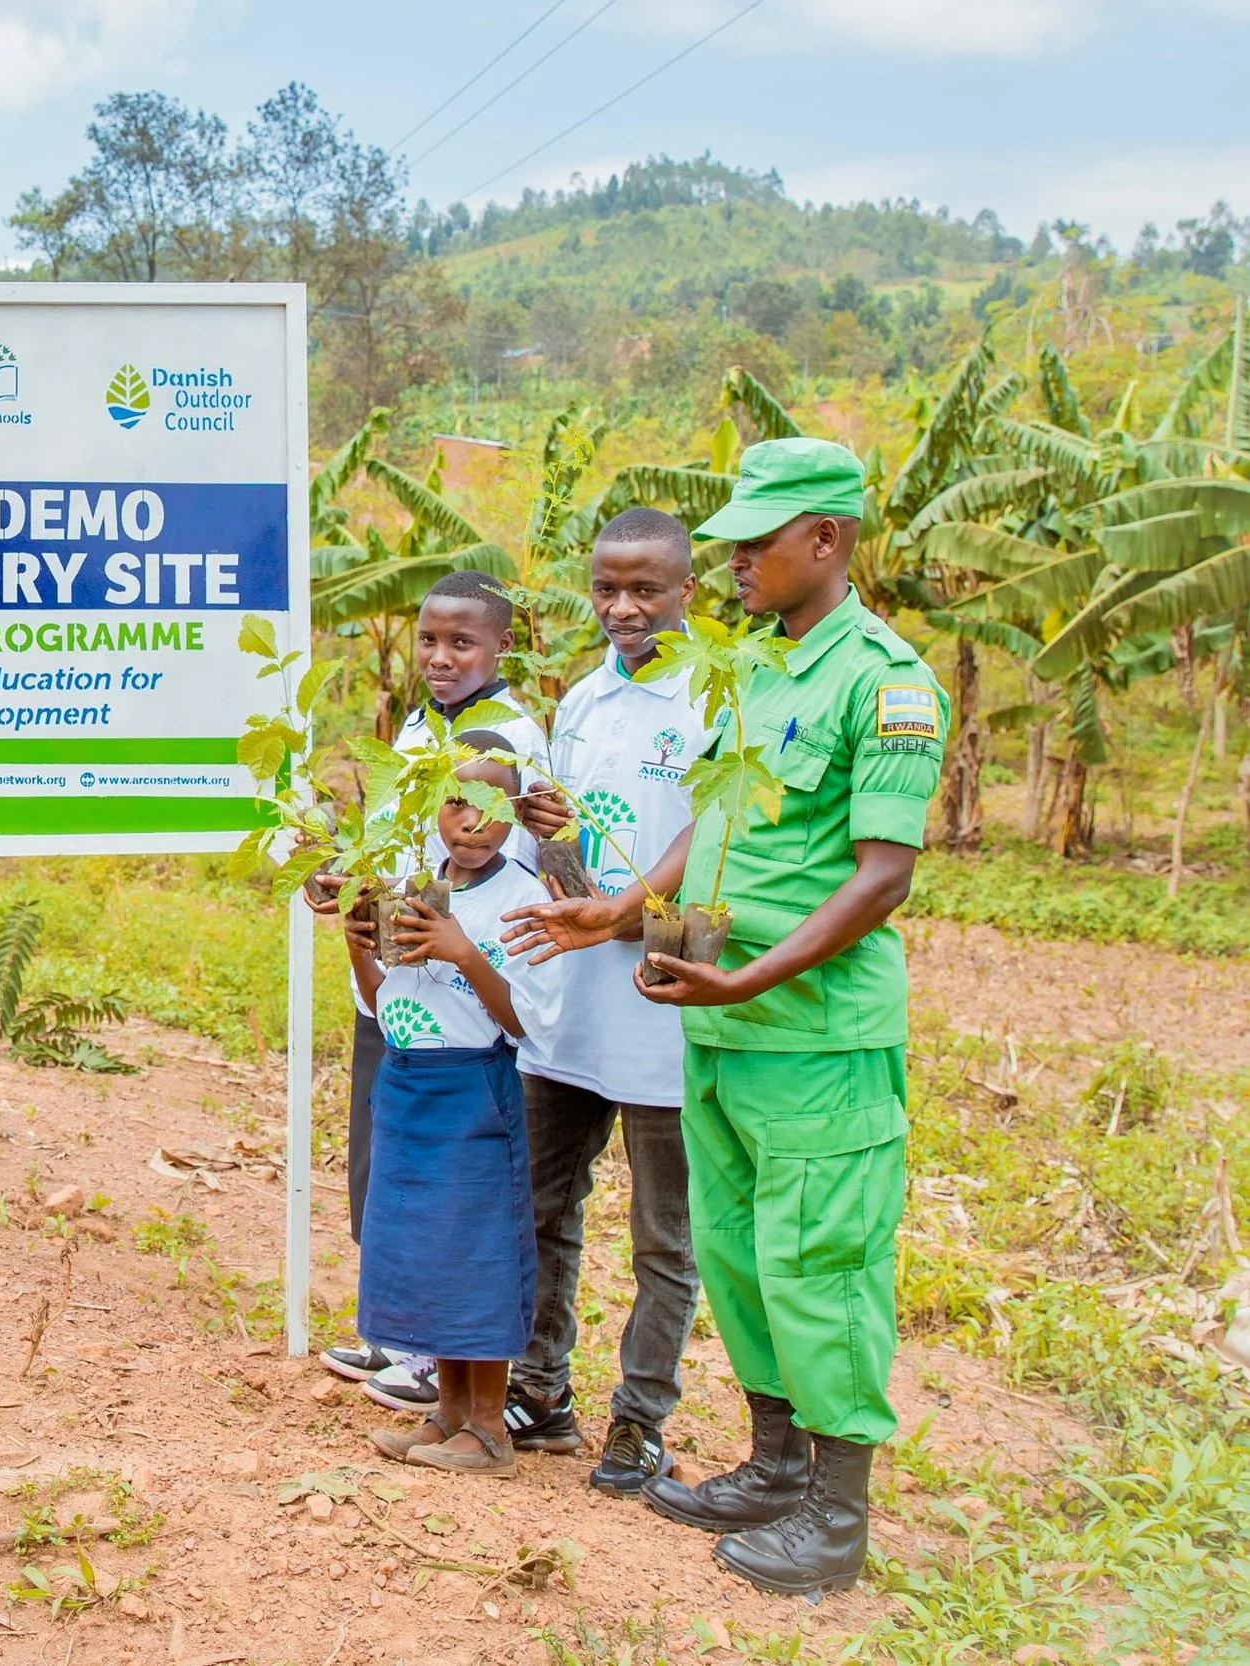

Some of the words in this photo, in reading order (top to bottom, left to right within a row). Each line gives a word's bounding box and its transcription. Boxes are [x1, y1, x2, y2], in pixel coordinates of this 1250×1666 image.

[152, 368, 233, 387] Danish
[175, 389, 252, 409] Outdoor
[165, 412, 234, 432] Council
[104, 552, 240, 604] SITE
[121, 666, 163, 690] for
[887, 723, 932, 734] RWANDA
[881, 738, 931, 753] KIREHE
[98, 775, 230, 788] www.arcosnetwork.org
